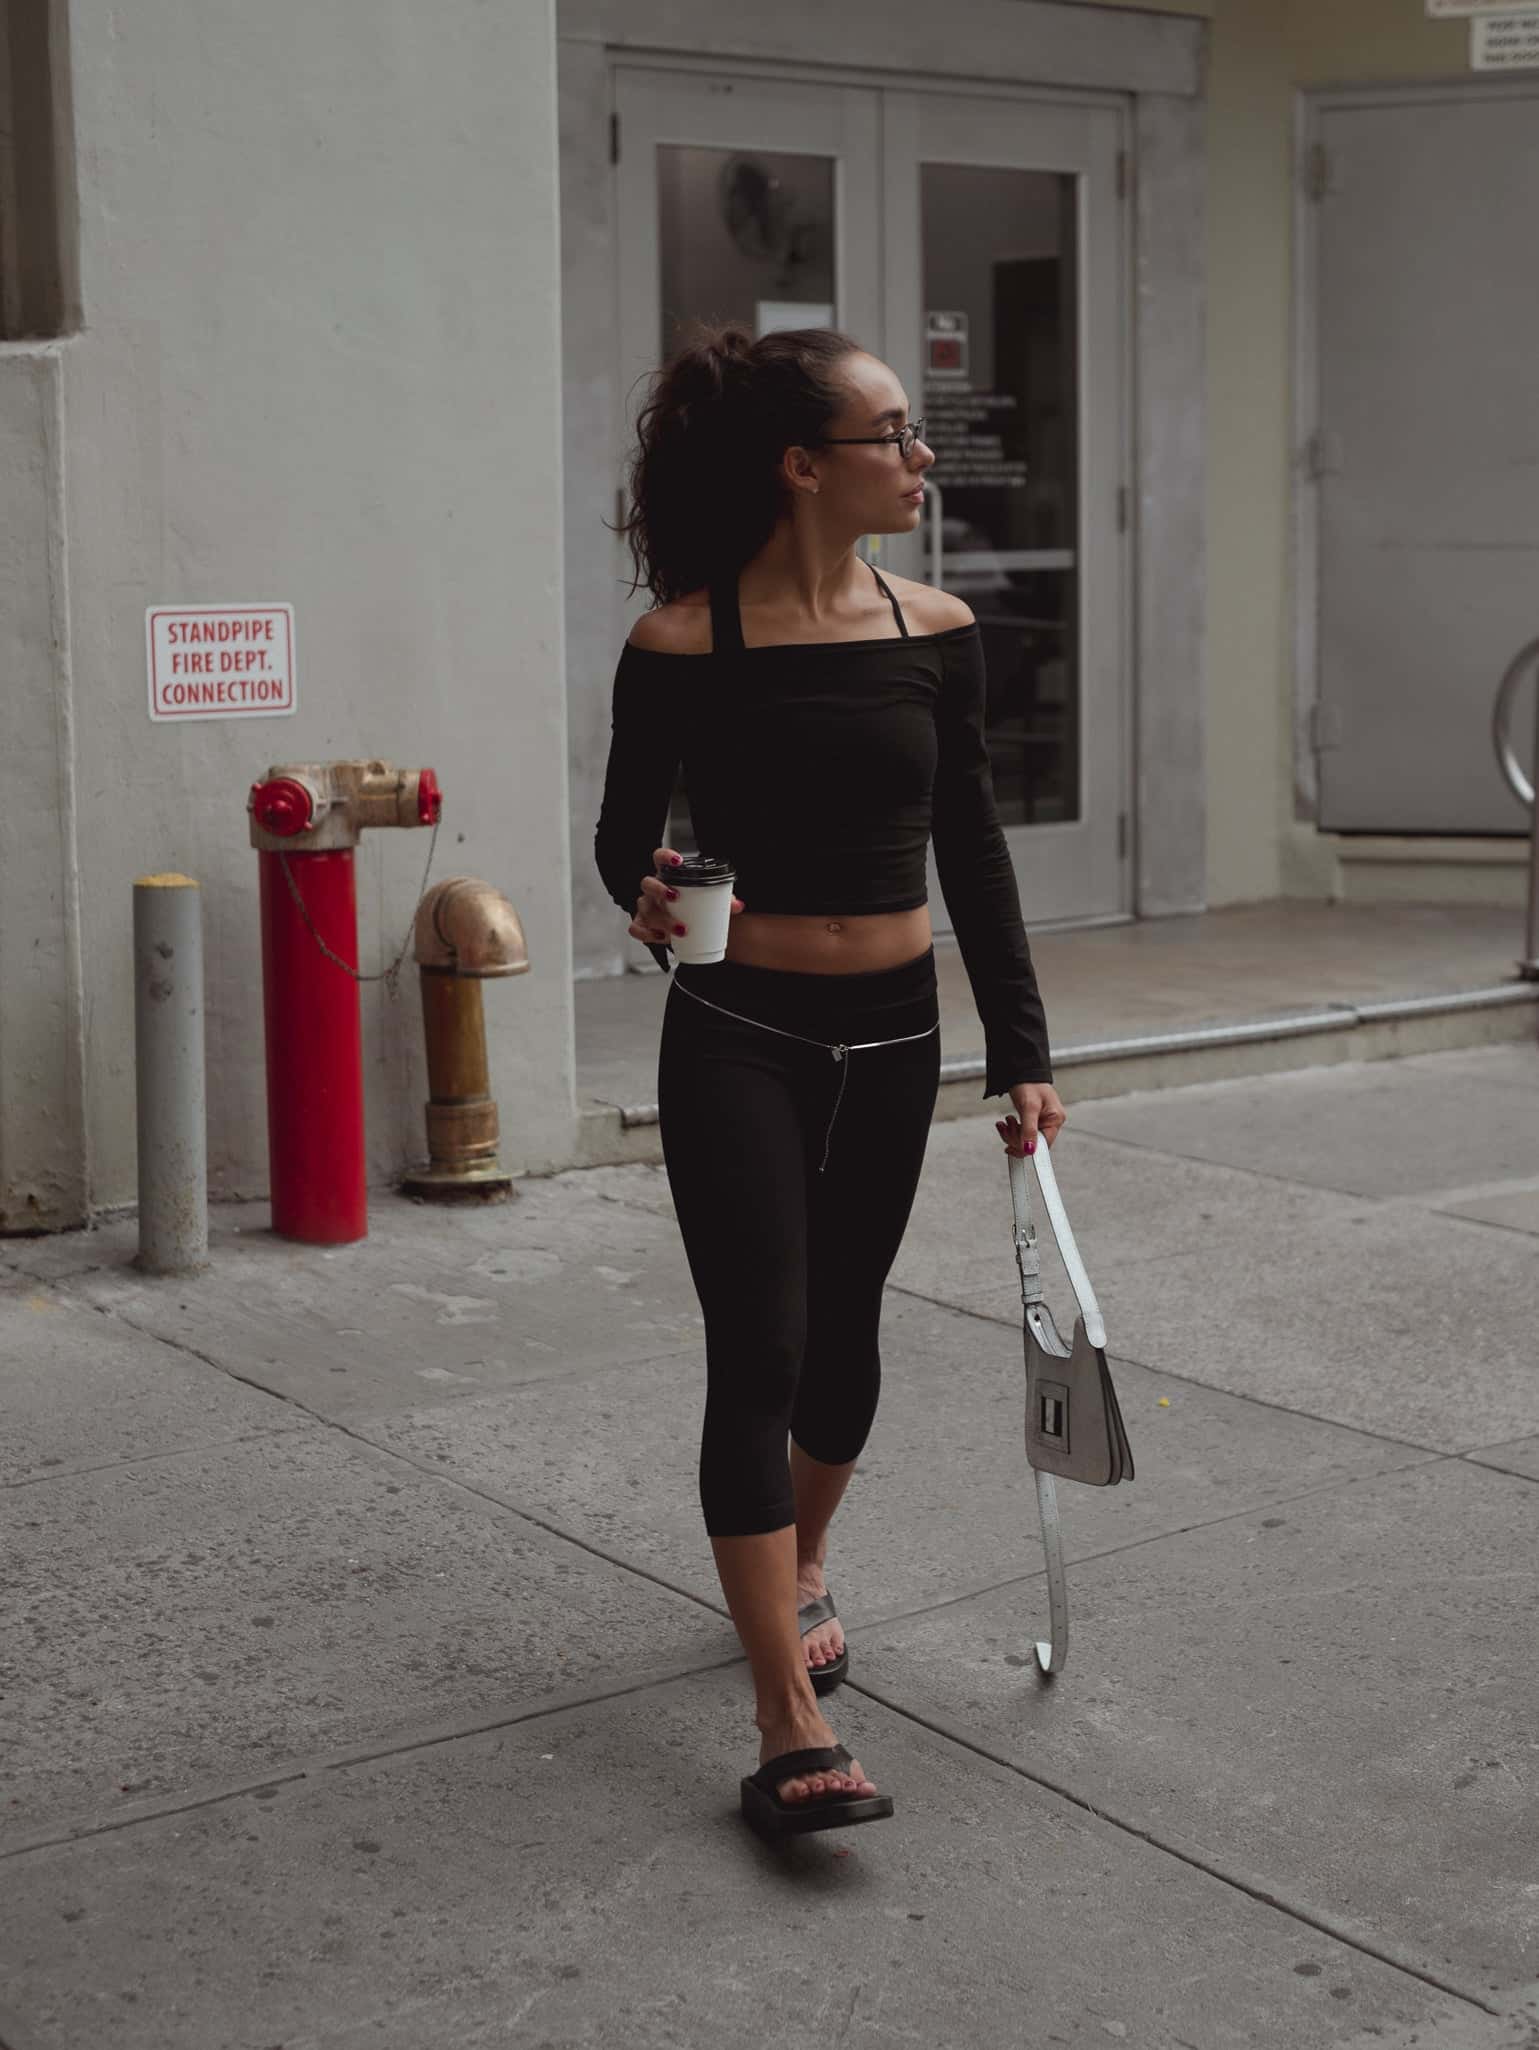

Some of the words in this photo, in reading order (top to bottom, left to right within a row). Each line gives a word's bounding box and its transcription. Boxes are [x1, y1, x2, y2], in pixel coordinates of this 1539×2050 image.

[168, 620, 274, 644] STANDPIPE
[172, 652, 214, 674] FIRE
[220, 650, 272, 673] DEPT.
[162, 679, 283, 705] CONNECTION
